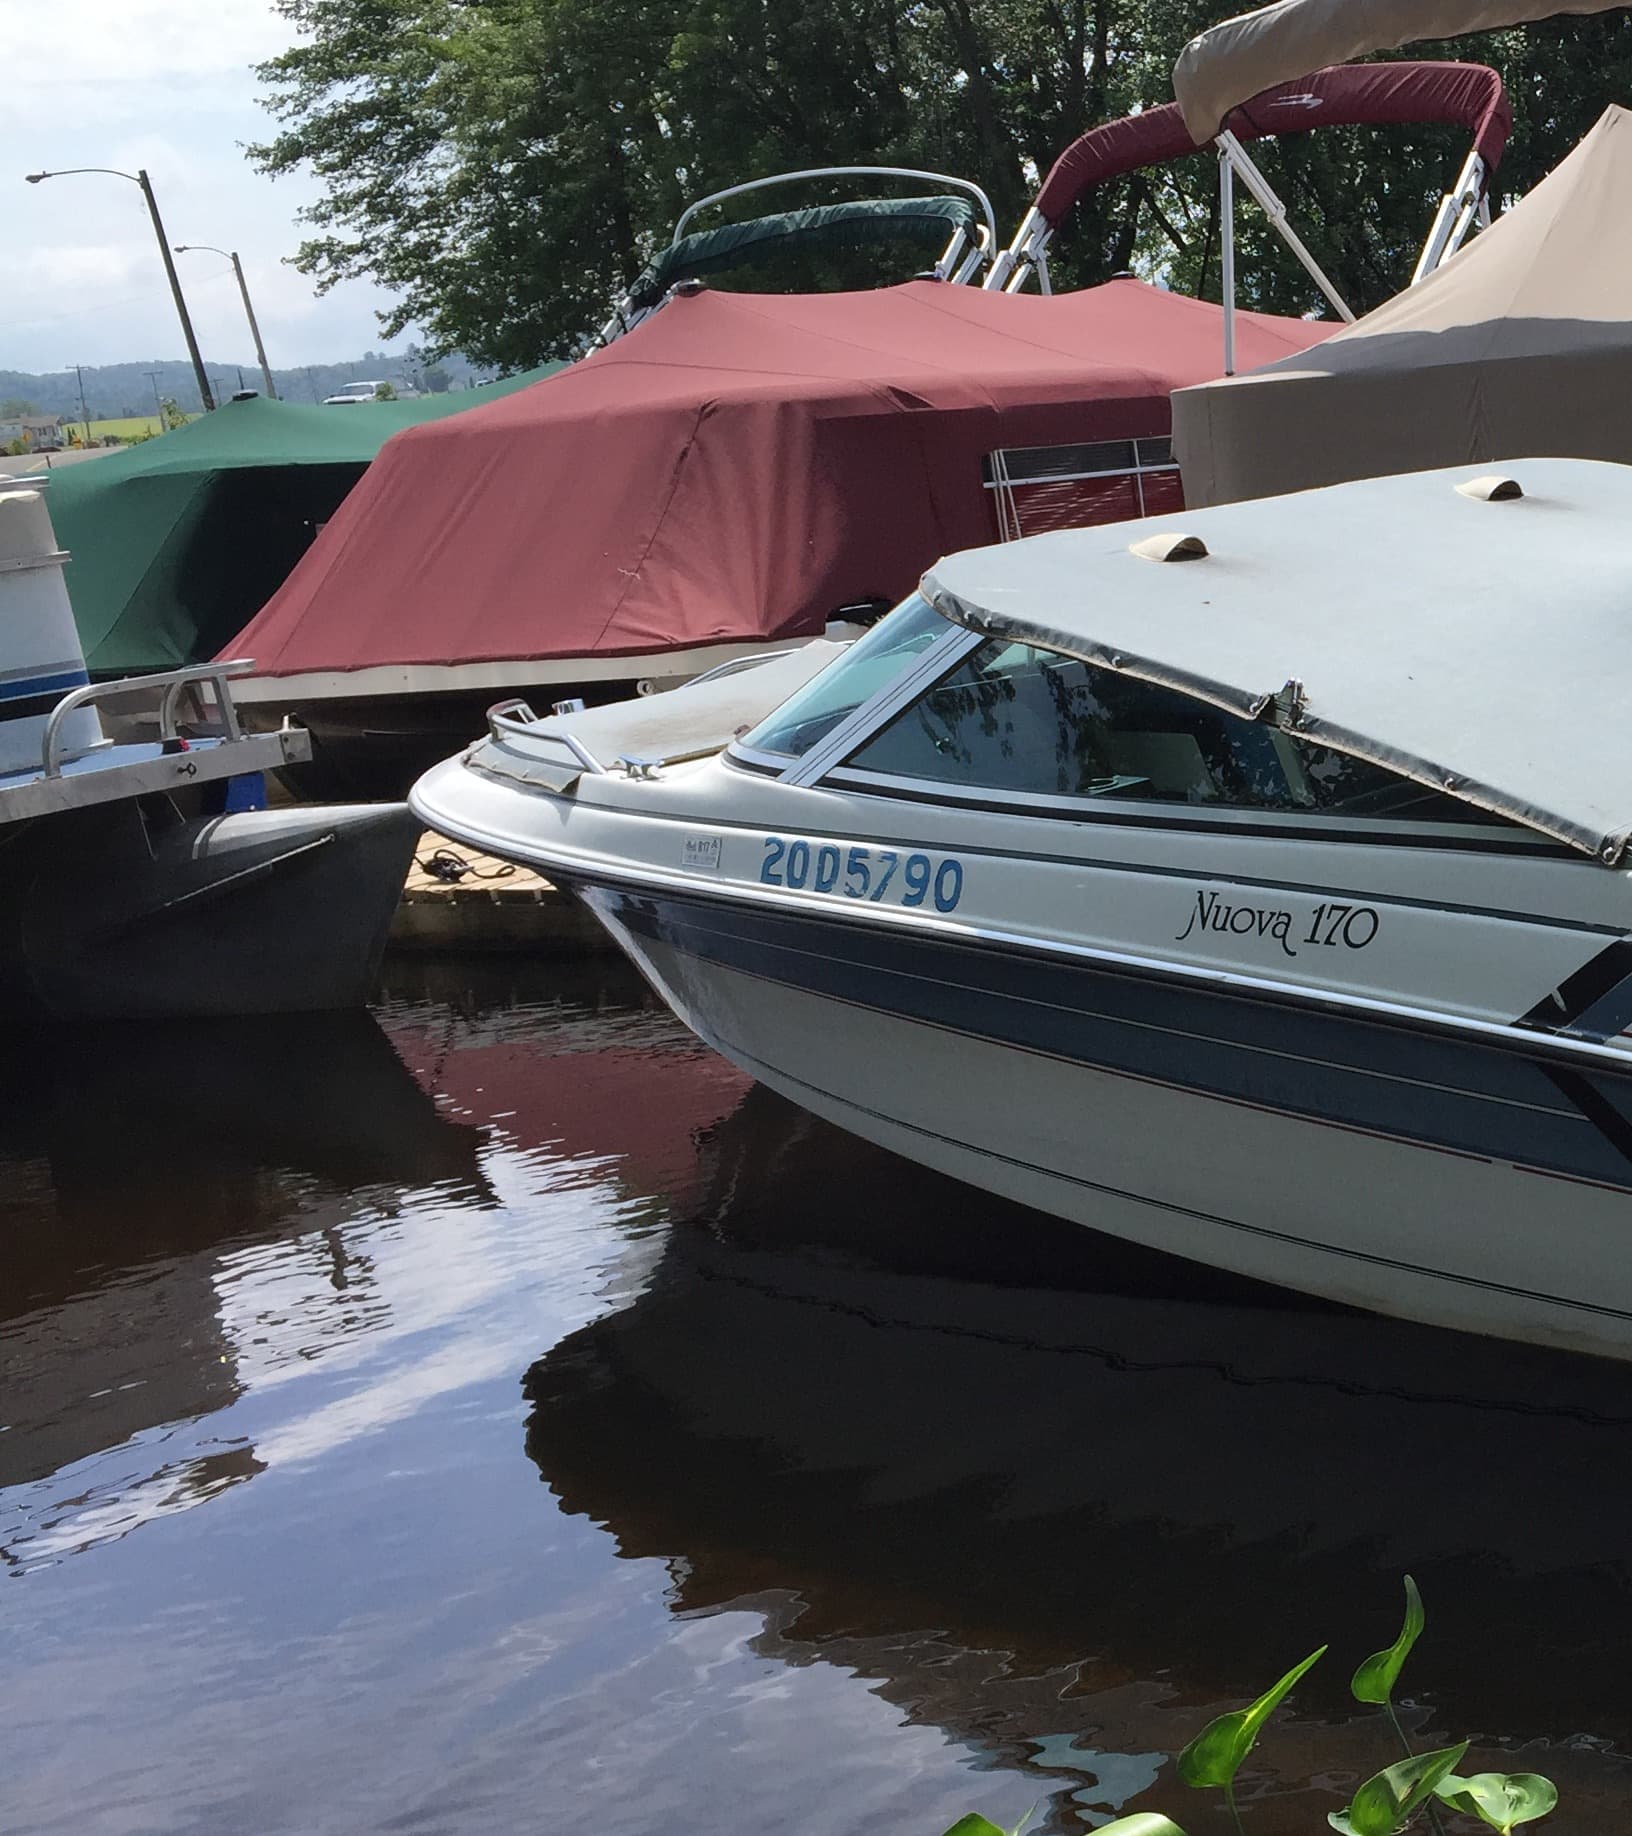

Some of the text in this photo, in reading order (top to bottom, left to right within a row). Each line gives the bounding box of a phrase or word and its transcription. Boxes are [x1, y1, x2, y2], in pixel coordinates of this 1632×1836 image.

[759, 836, 963, 913] 20D5790
[1175, 890, 1379, 957] Nuova 170
